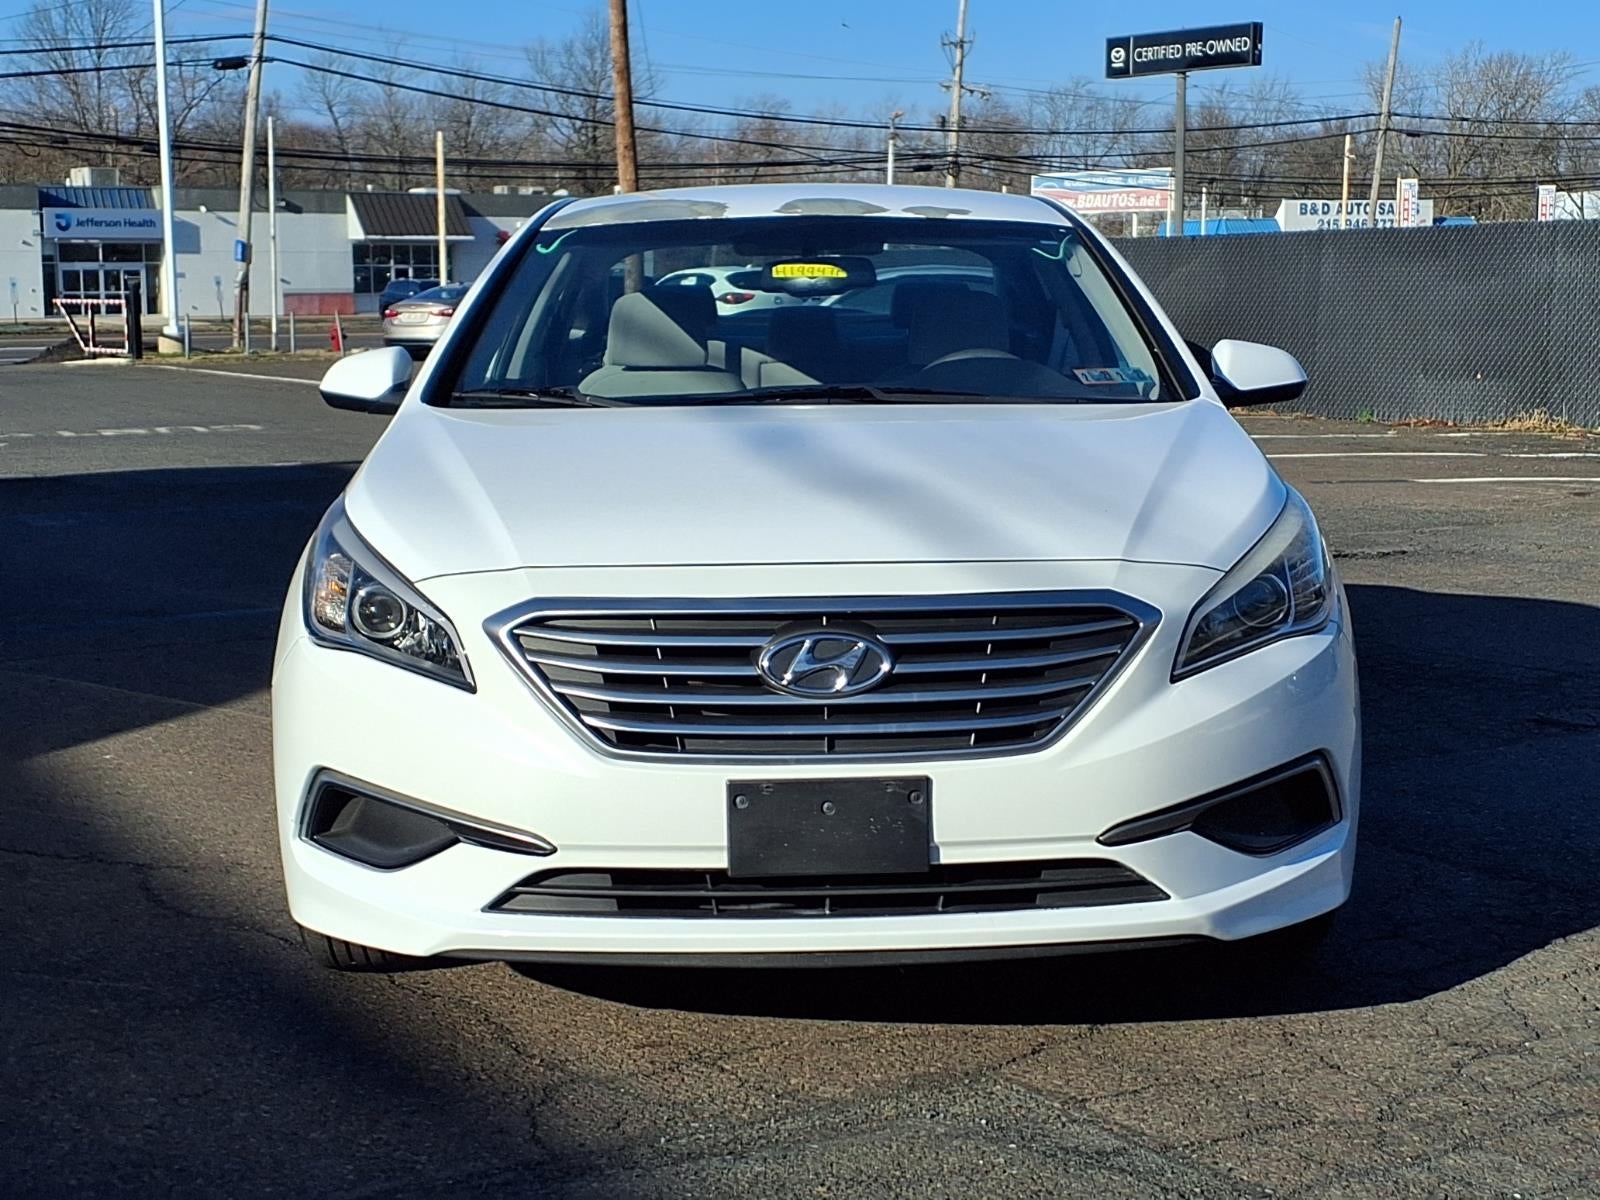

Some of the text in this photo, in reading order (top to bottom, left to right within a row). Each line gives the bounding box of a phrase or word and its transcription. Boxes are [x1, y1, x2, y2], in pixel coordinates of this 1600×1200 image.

[1134, 37, 1250, 62] CERTIFIED PRE-OWNED
[1062, 193, 1161, 209] w.BDAUTOS.net
[1299, 203, 1330, 215] B&D
[75, 217, 157, 228] Jefferson Health
